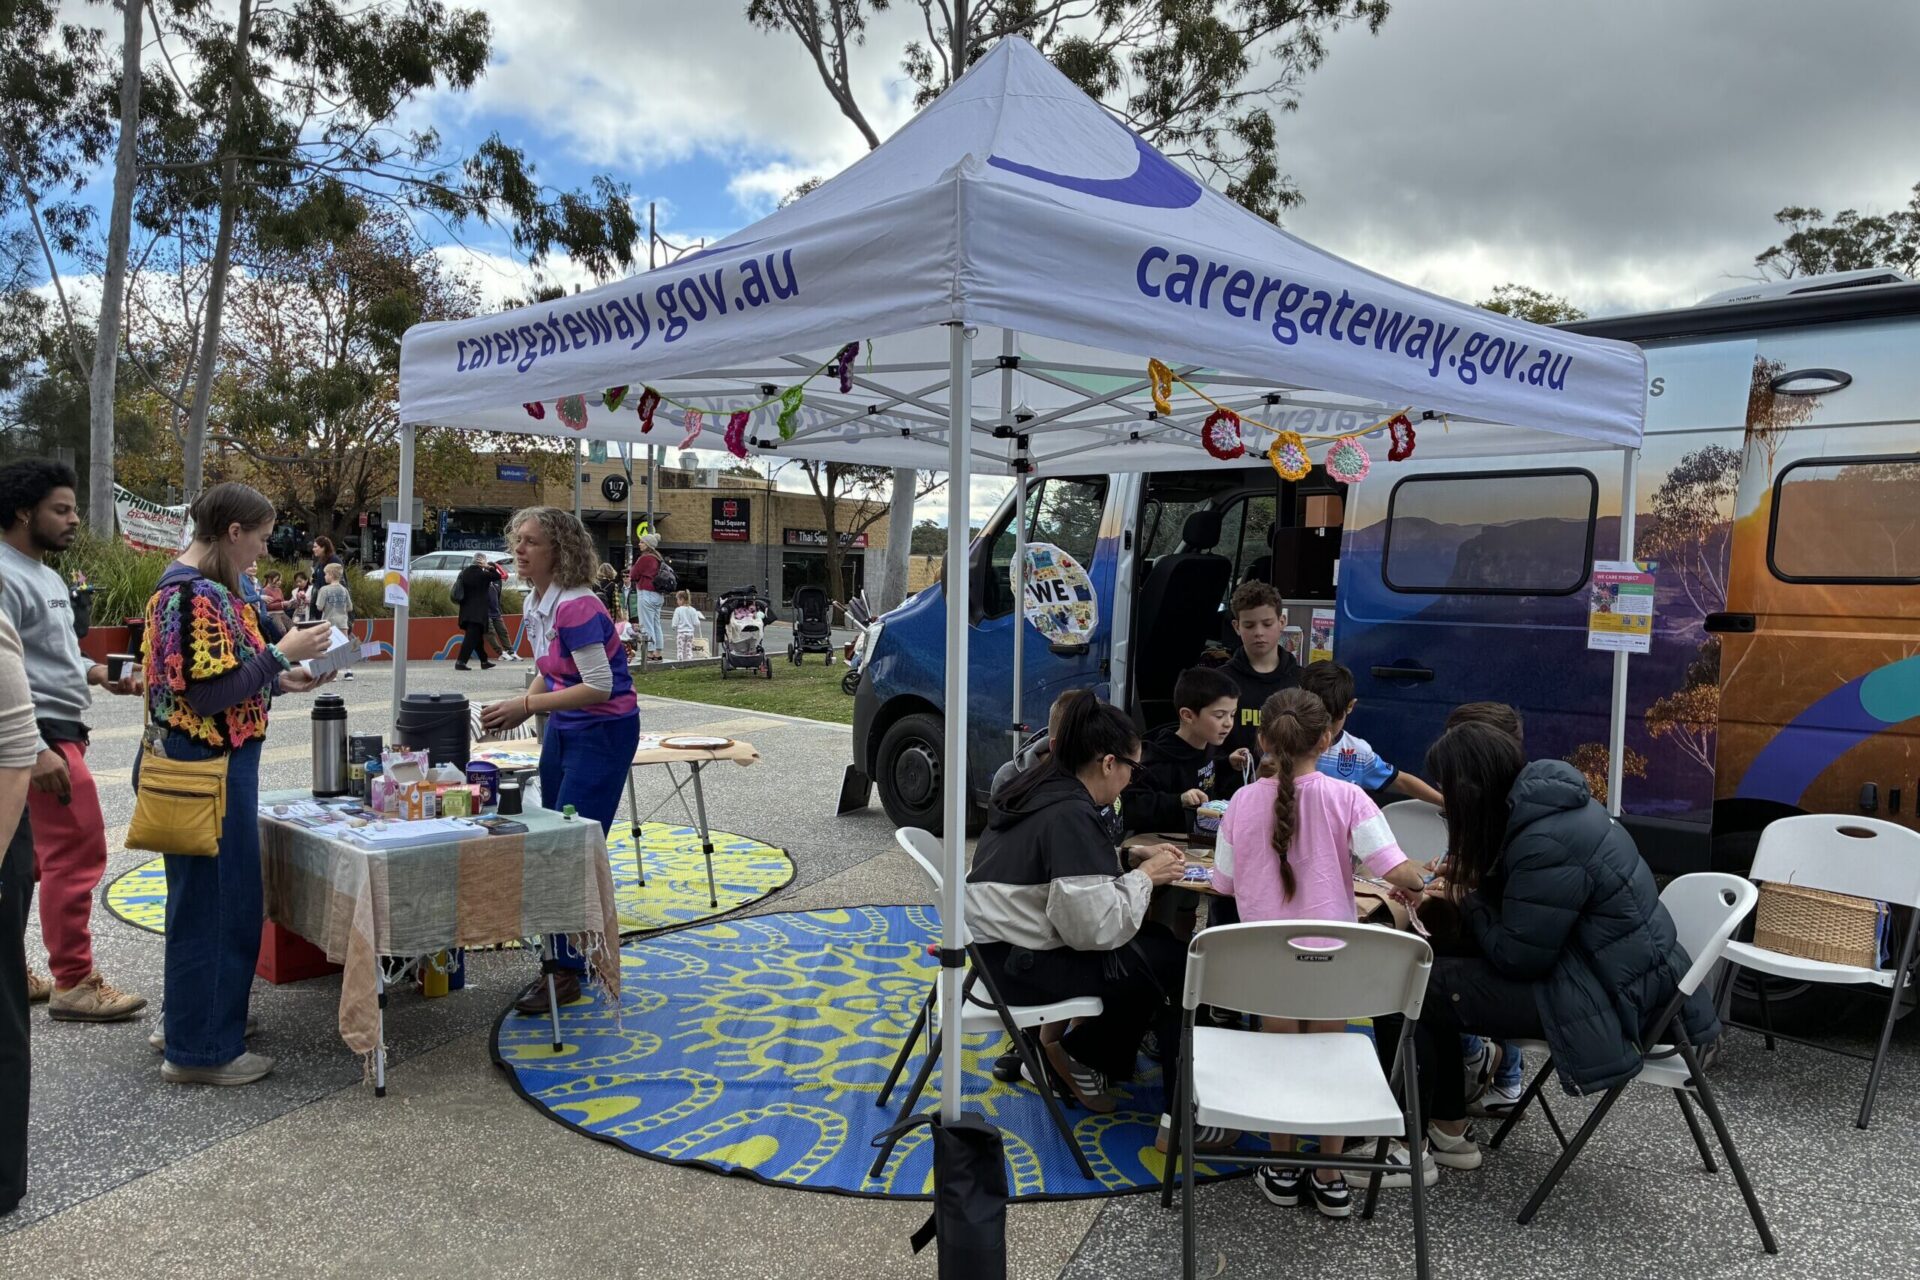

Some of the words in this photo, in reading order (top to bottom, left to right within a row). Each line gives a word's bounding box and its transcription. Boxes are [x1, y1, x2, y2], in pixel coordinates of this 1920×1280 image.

[457, 249, 800, 373] carergateway.gov.au
[1136, 246, 1574, 390] carergateway.gov.au
[608, 481, 625, 491] 107
[726, 520, 746, 528] Square
[799, 531, 813, 542] Thai
[1028, 579, 1070, 604] WE
[1241, 708, 1261, 726] PU
